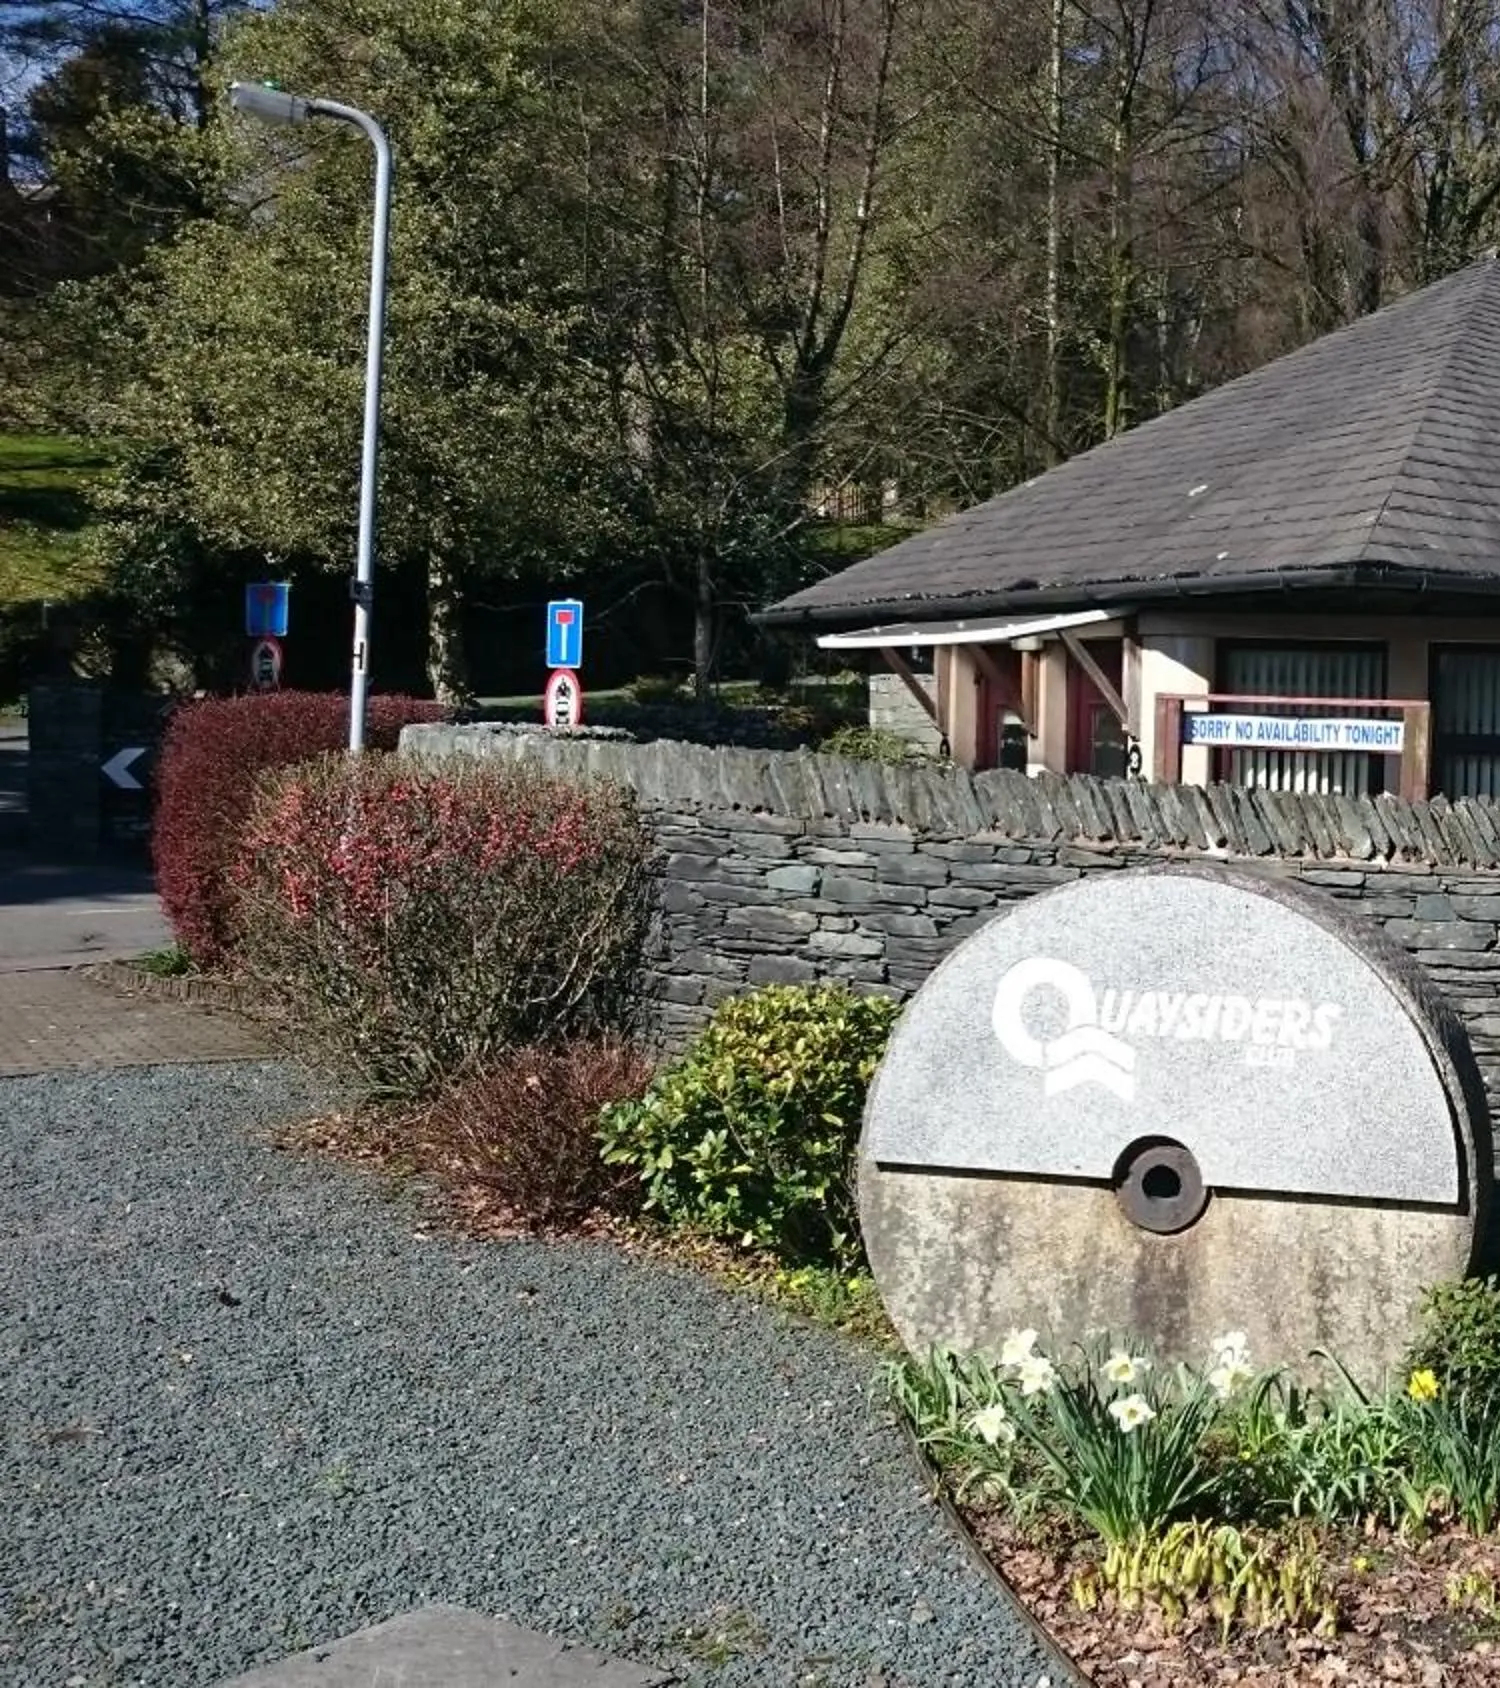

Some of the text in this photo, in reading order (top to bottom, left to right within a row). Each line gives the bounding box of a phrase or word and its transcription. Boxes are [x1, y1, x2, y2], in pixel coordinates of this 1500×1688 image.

[1191, 719, 1401, 745] SORRY NO AVAILABILITY TONIGHT
[992, 956, 1343, 1100] QUAYSIDERS
